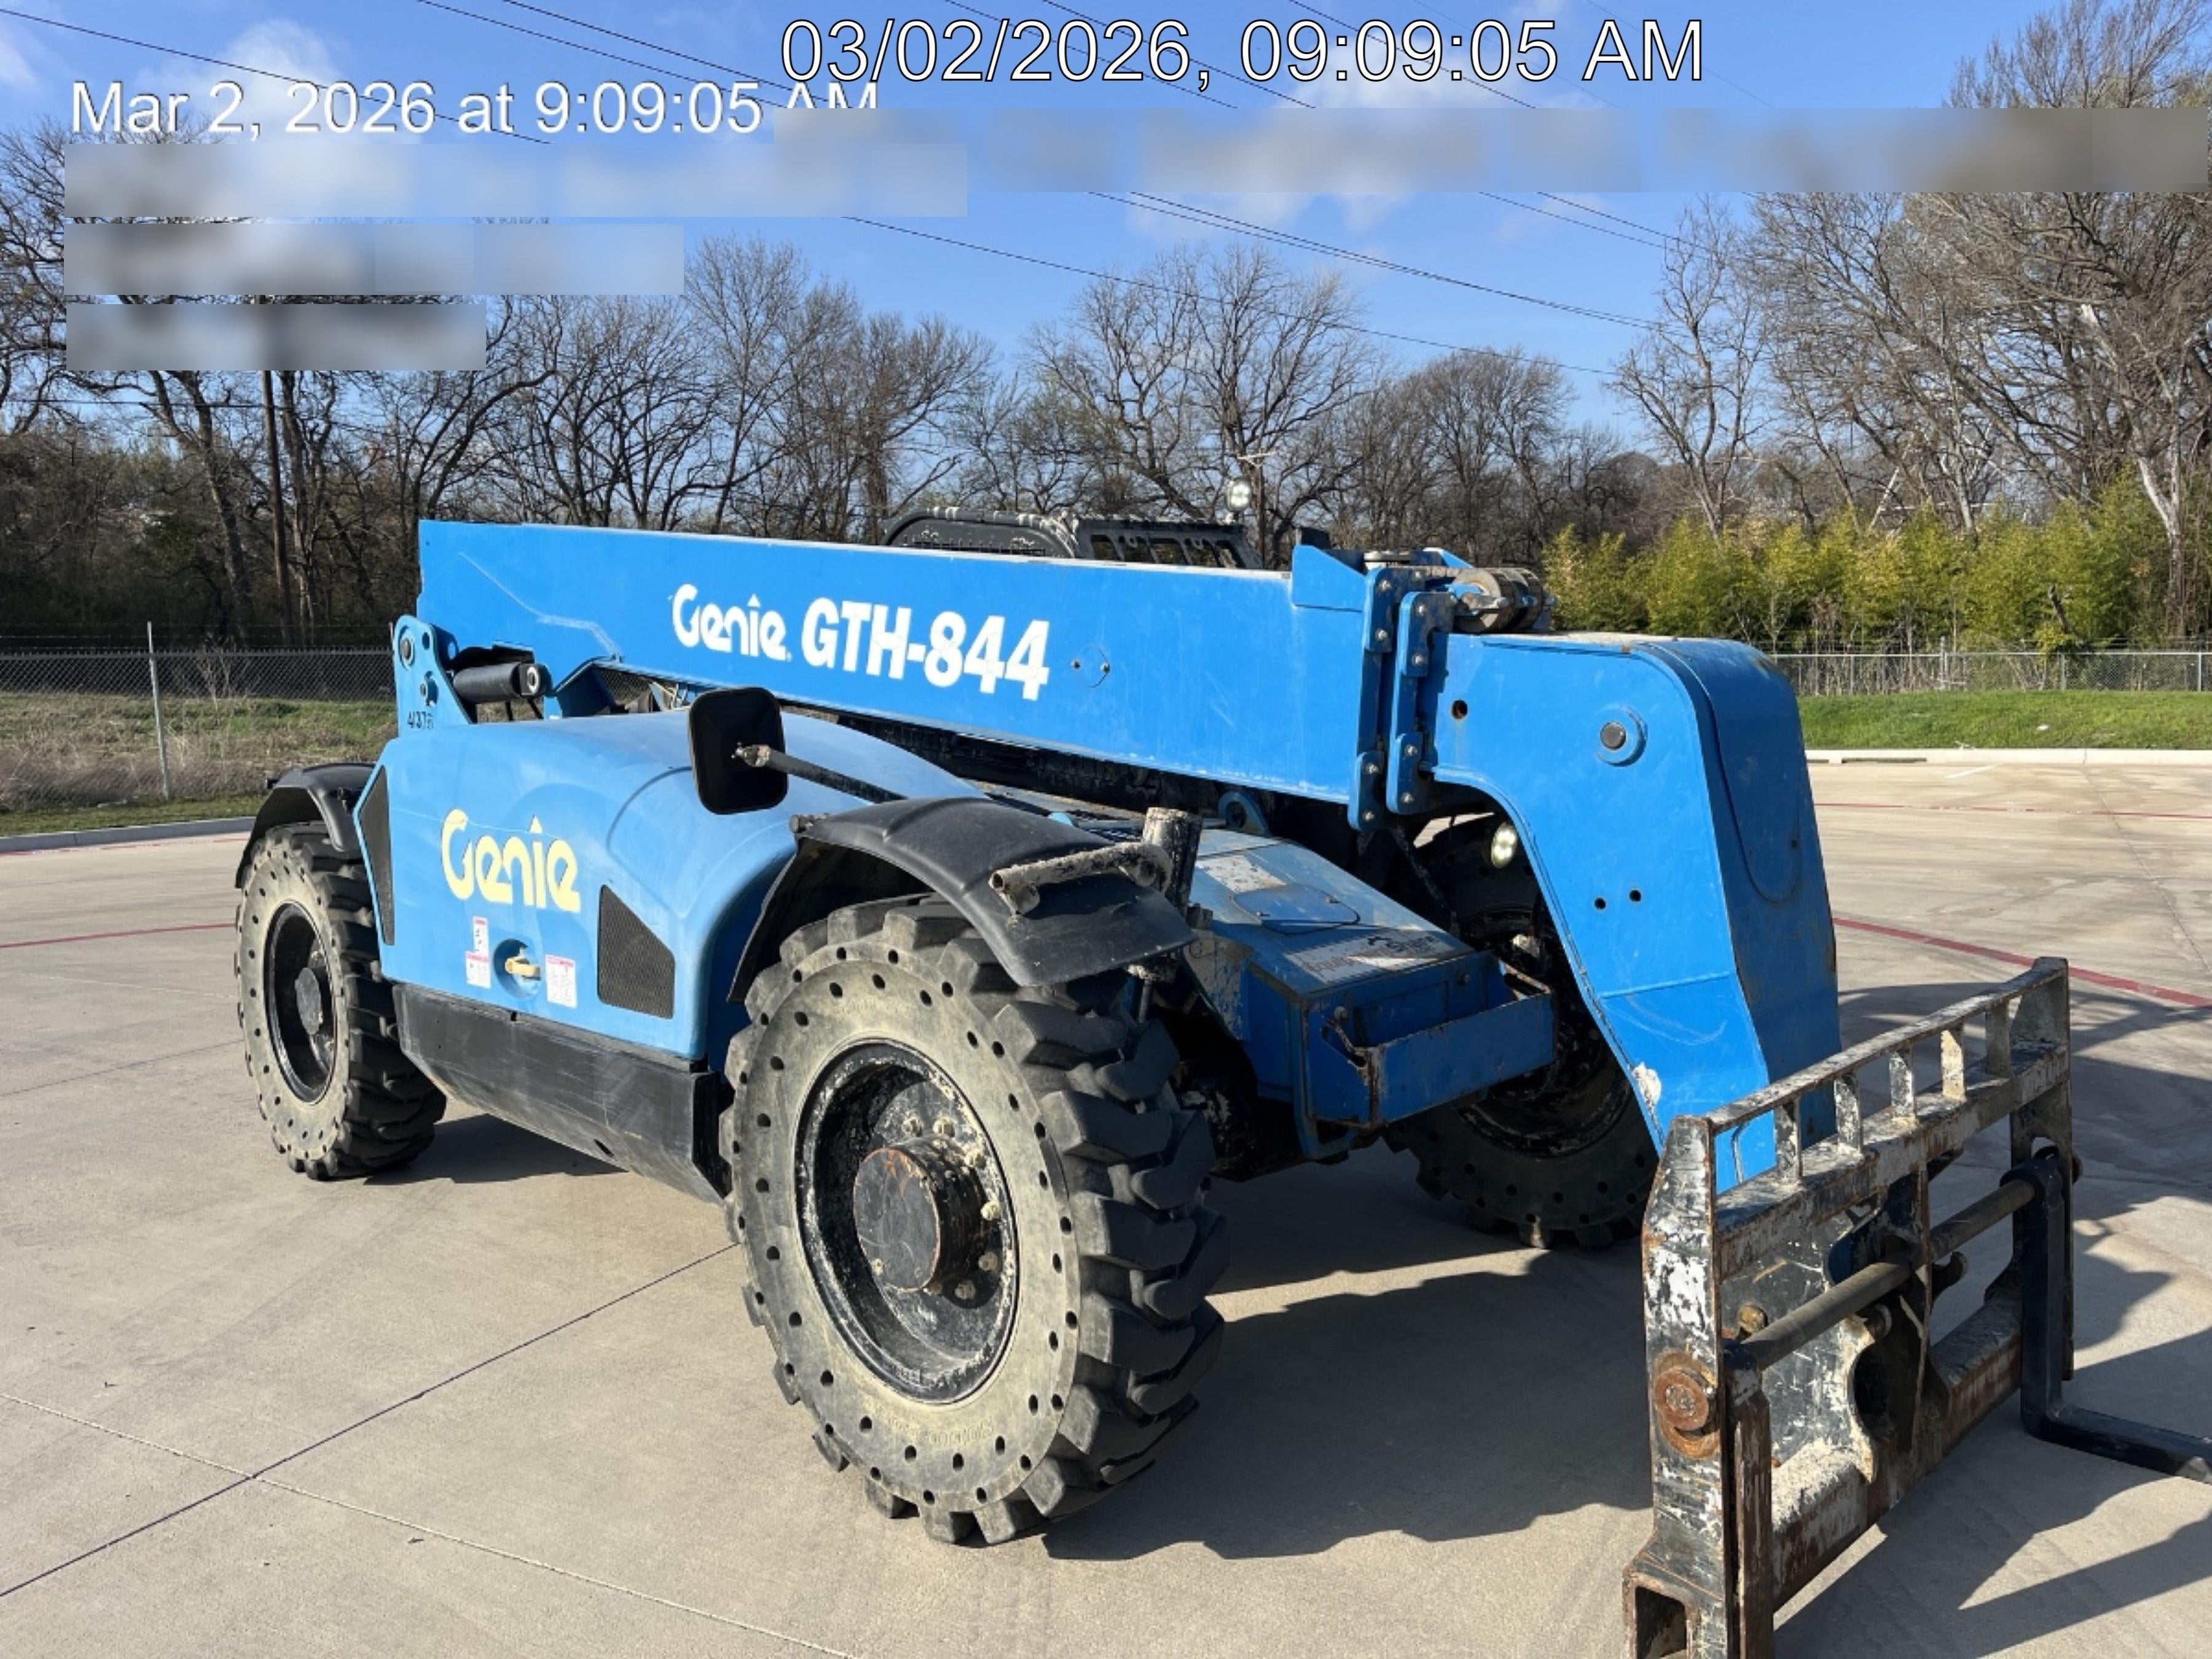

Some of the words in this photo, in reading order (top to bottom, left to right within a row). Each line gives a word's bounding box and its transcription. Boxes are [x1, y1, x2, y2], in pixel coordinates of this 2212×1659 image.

[672, 583, 788, 662] Genie
[801, 597, 1050, 701] GTH-844
[441, 808, 581, 914] Genie
